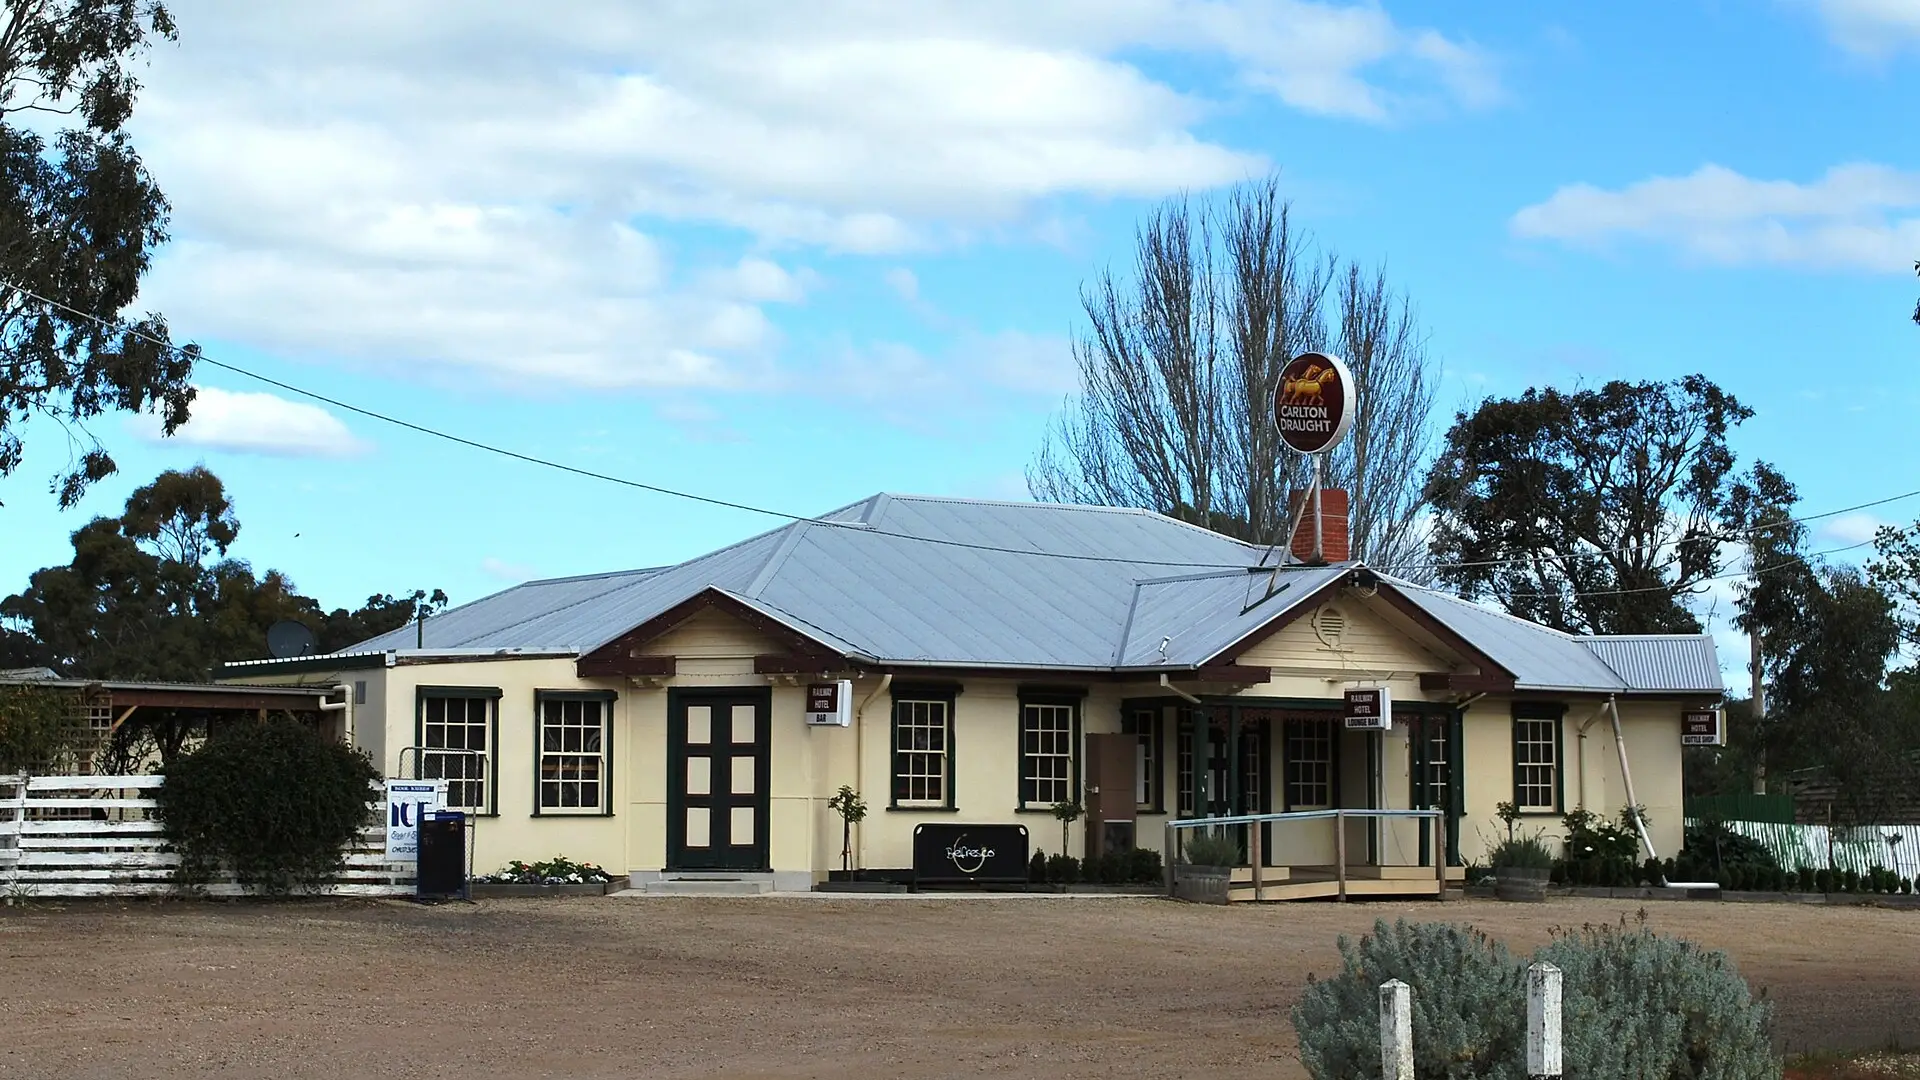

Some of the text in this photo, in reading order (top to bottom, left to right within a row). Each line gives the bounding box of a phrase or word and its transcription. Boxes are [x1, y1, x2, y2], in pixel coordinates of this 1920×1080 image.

[1281, 405, 1327, 418] CARLTON
[1280, 418, 1331, 432] DRAUGHT
[813, 688, 832, 696] RAILWAY
[815, 700, 829, 708] HOTEL
[816, 714, 826, 722] BAR
[1348, 718, 1379, 726] LOUNGE BAR
